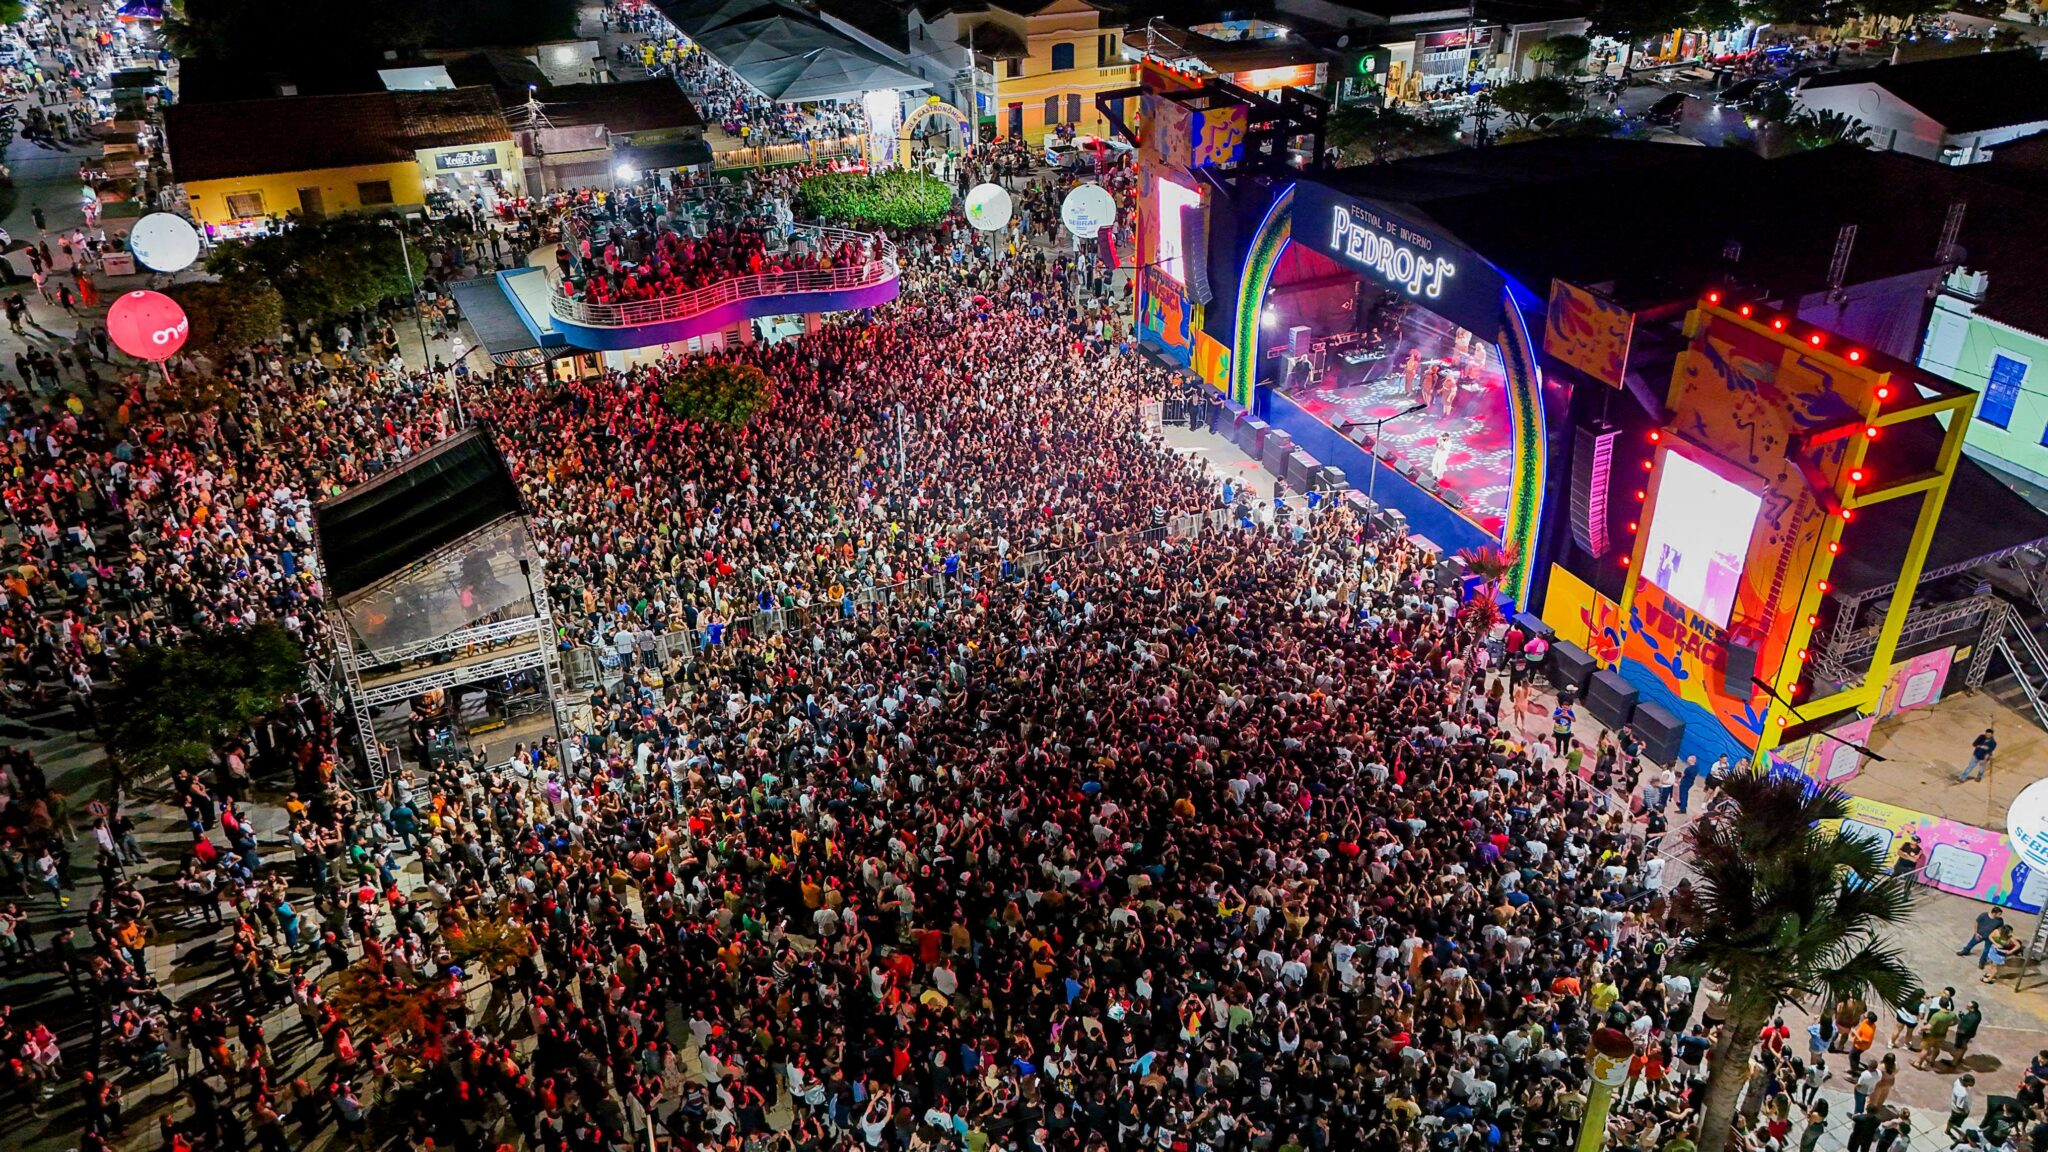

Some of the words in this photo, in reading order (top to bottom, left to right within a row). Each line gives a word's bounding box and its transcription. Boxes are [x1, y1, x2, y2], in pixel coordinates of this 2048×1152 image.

[1351, 204, 1383, 229] FESTIVAL
[1386, 221, 1397, 236] DE
[1400, 227, 1432, 251] INVERNO
[1662, 595, 1686, 624] NA
